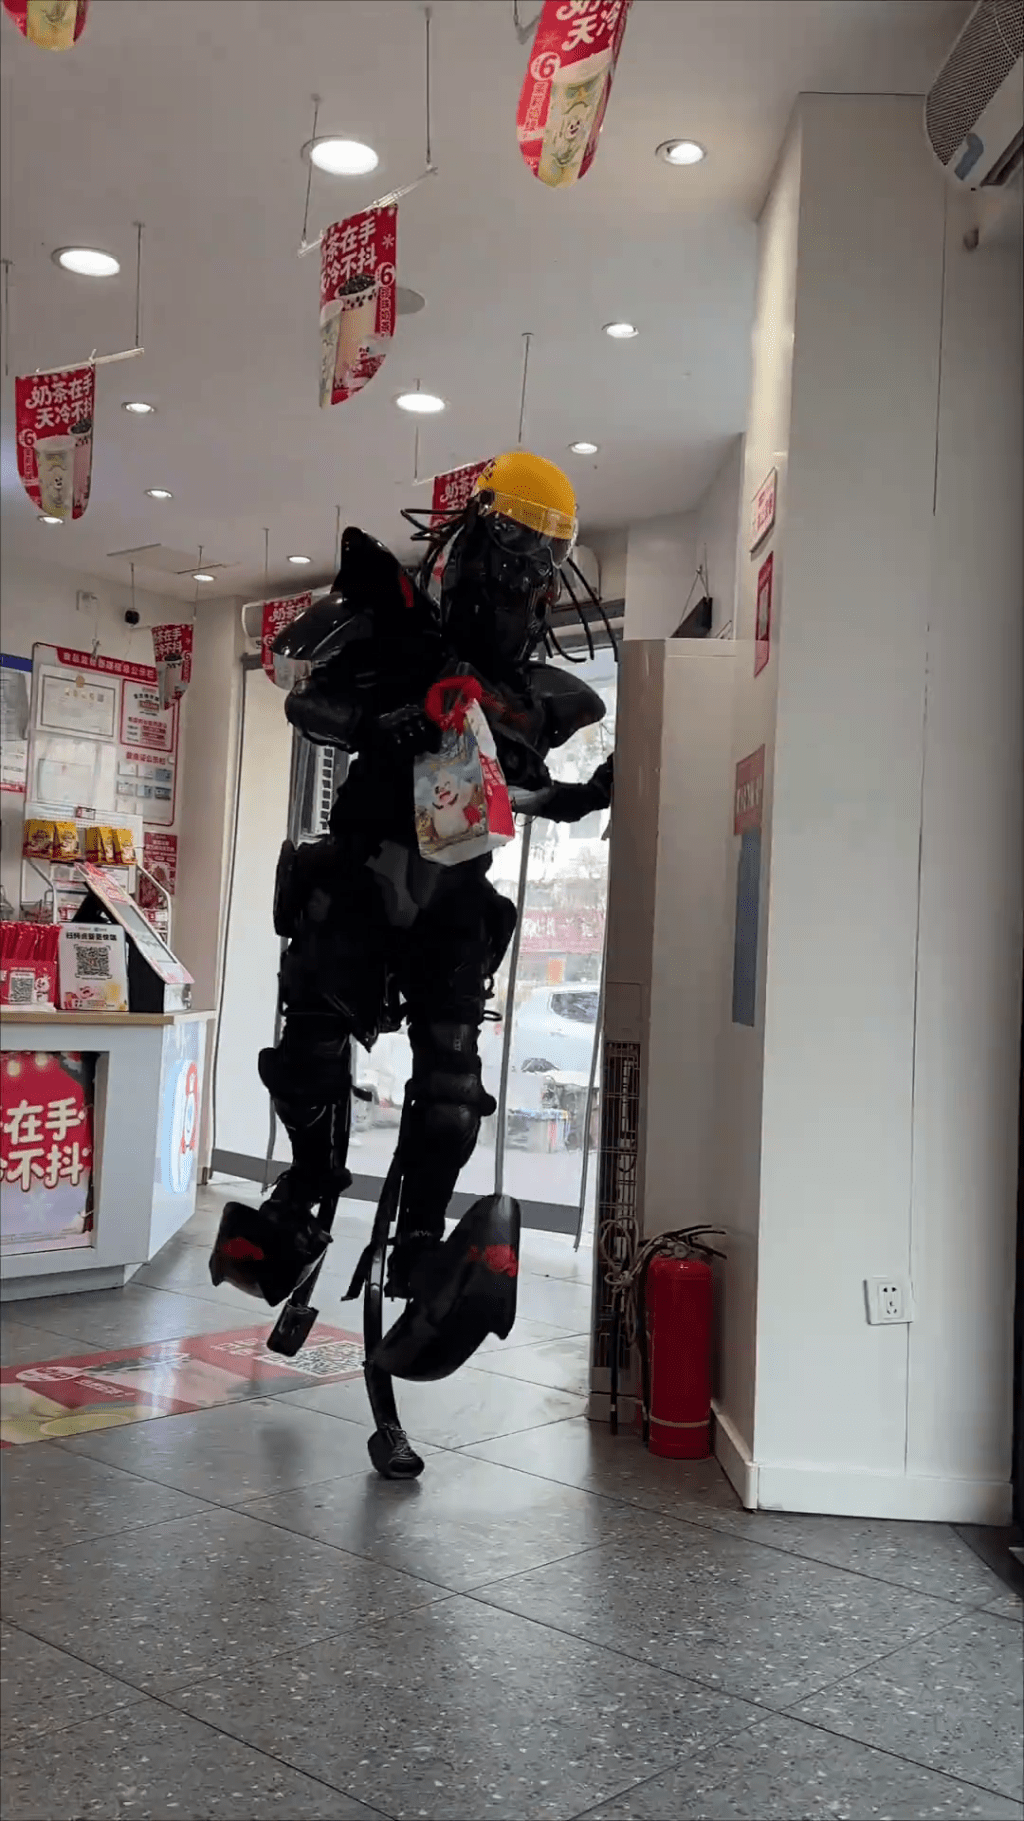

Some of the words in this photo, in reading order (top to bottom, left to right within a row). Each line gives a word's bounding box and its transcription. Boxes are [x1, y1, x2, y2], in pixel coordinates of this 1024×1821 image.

[539, 54, 557, 78] 6
[381, 264, 393, 286] 6
[25, 372, 92, 409] 奶茶在手
[35, 396, 92, 429] 天冷不抖
[24, 431, 35, 446] 6
[4, 1097, 82, 1145] 在手
[0, 1142, 84, 1193] 不抖
